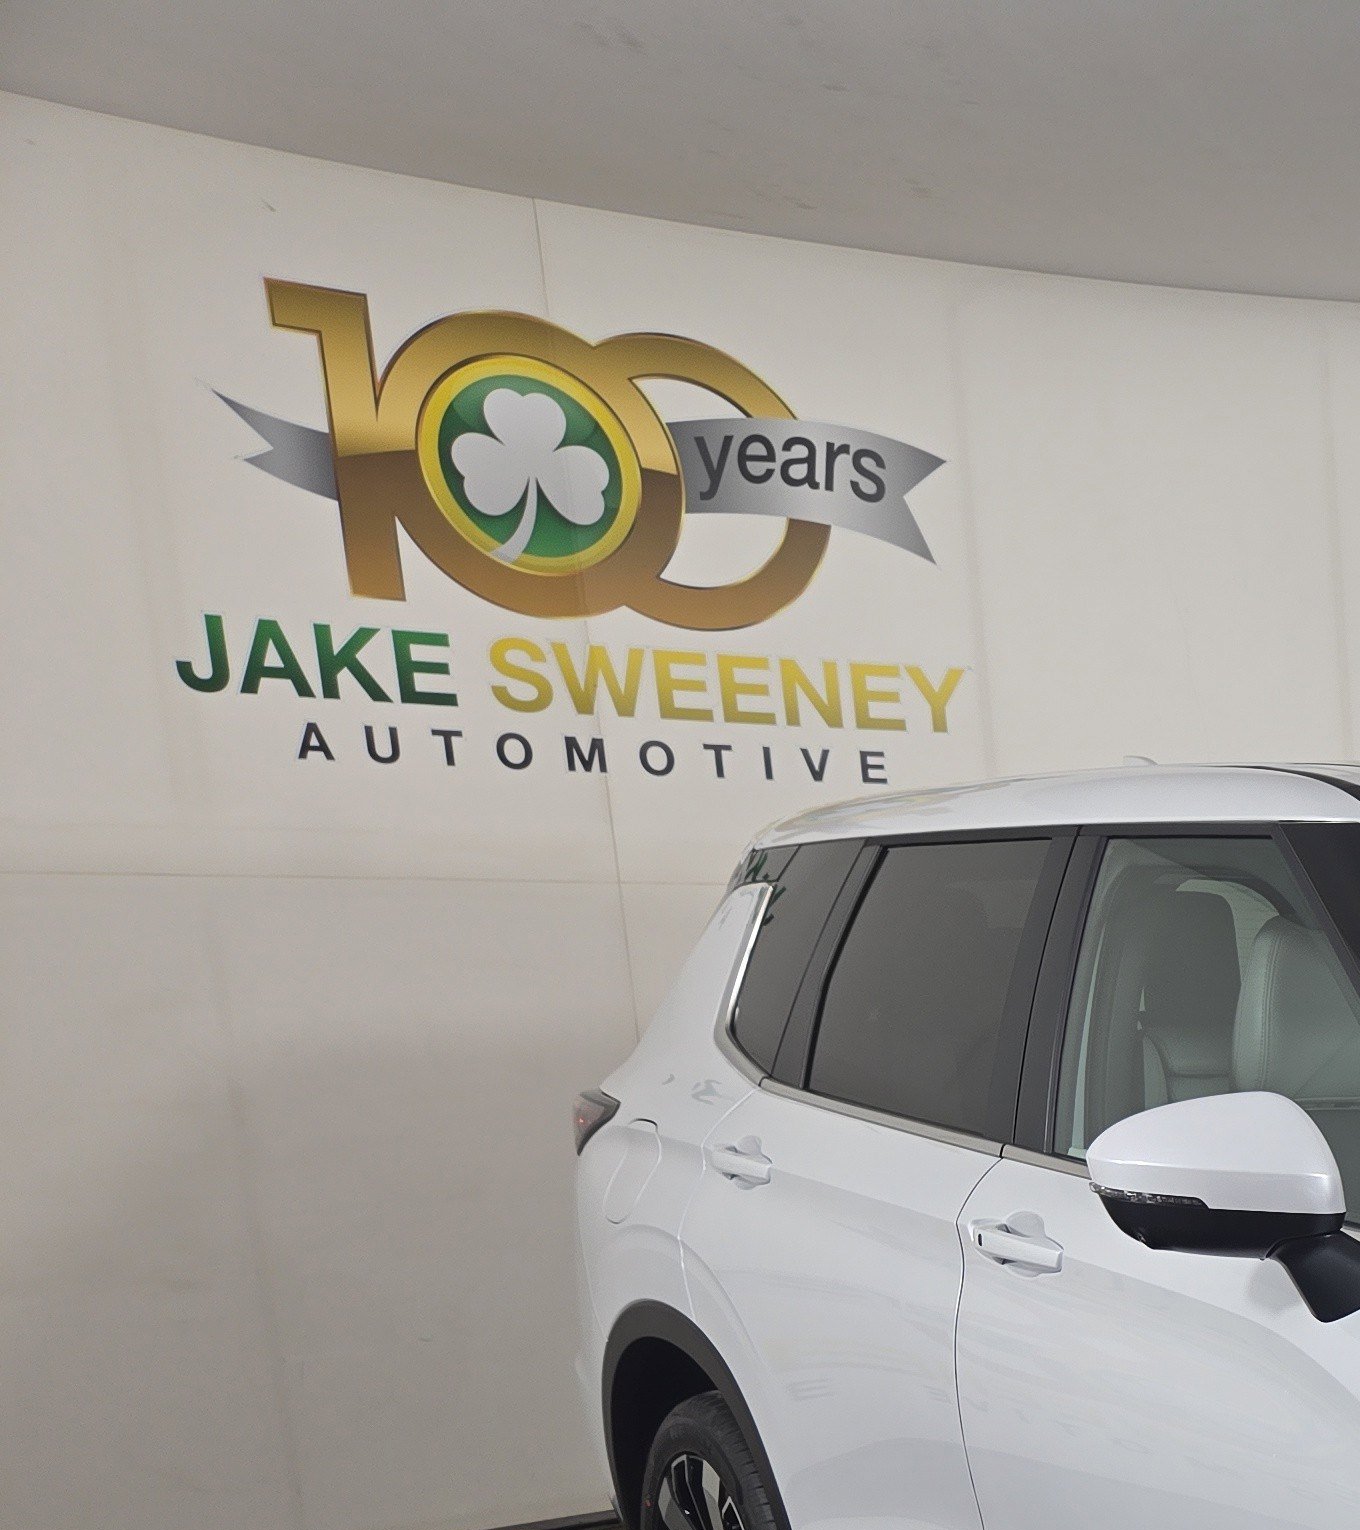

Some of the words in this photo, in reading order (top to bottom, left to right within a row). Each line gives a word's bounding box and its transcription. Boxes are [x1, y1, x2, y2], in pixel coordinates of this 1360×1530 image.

[263, 277, 832, 631] 100
[694, 432, 887, 503] years
[176, 612, 460, 708] JAKE
[490, 636, 966, 733] SWEENEY
[297, 721, 889, 785] AUTOMOTIVE
